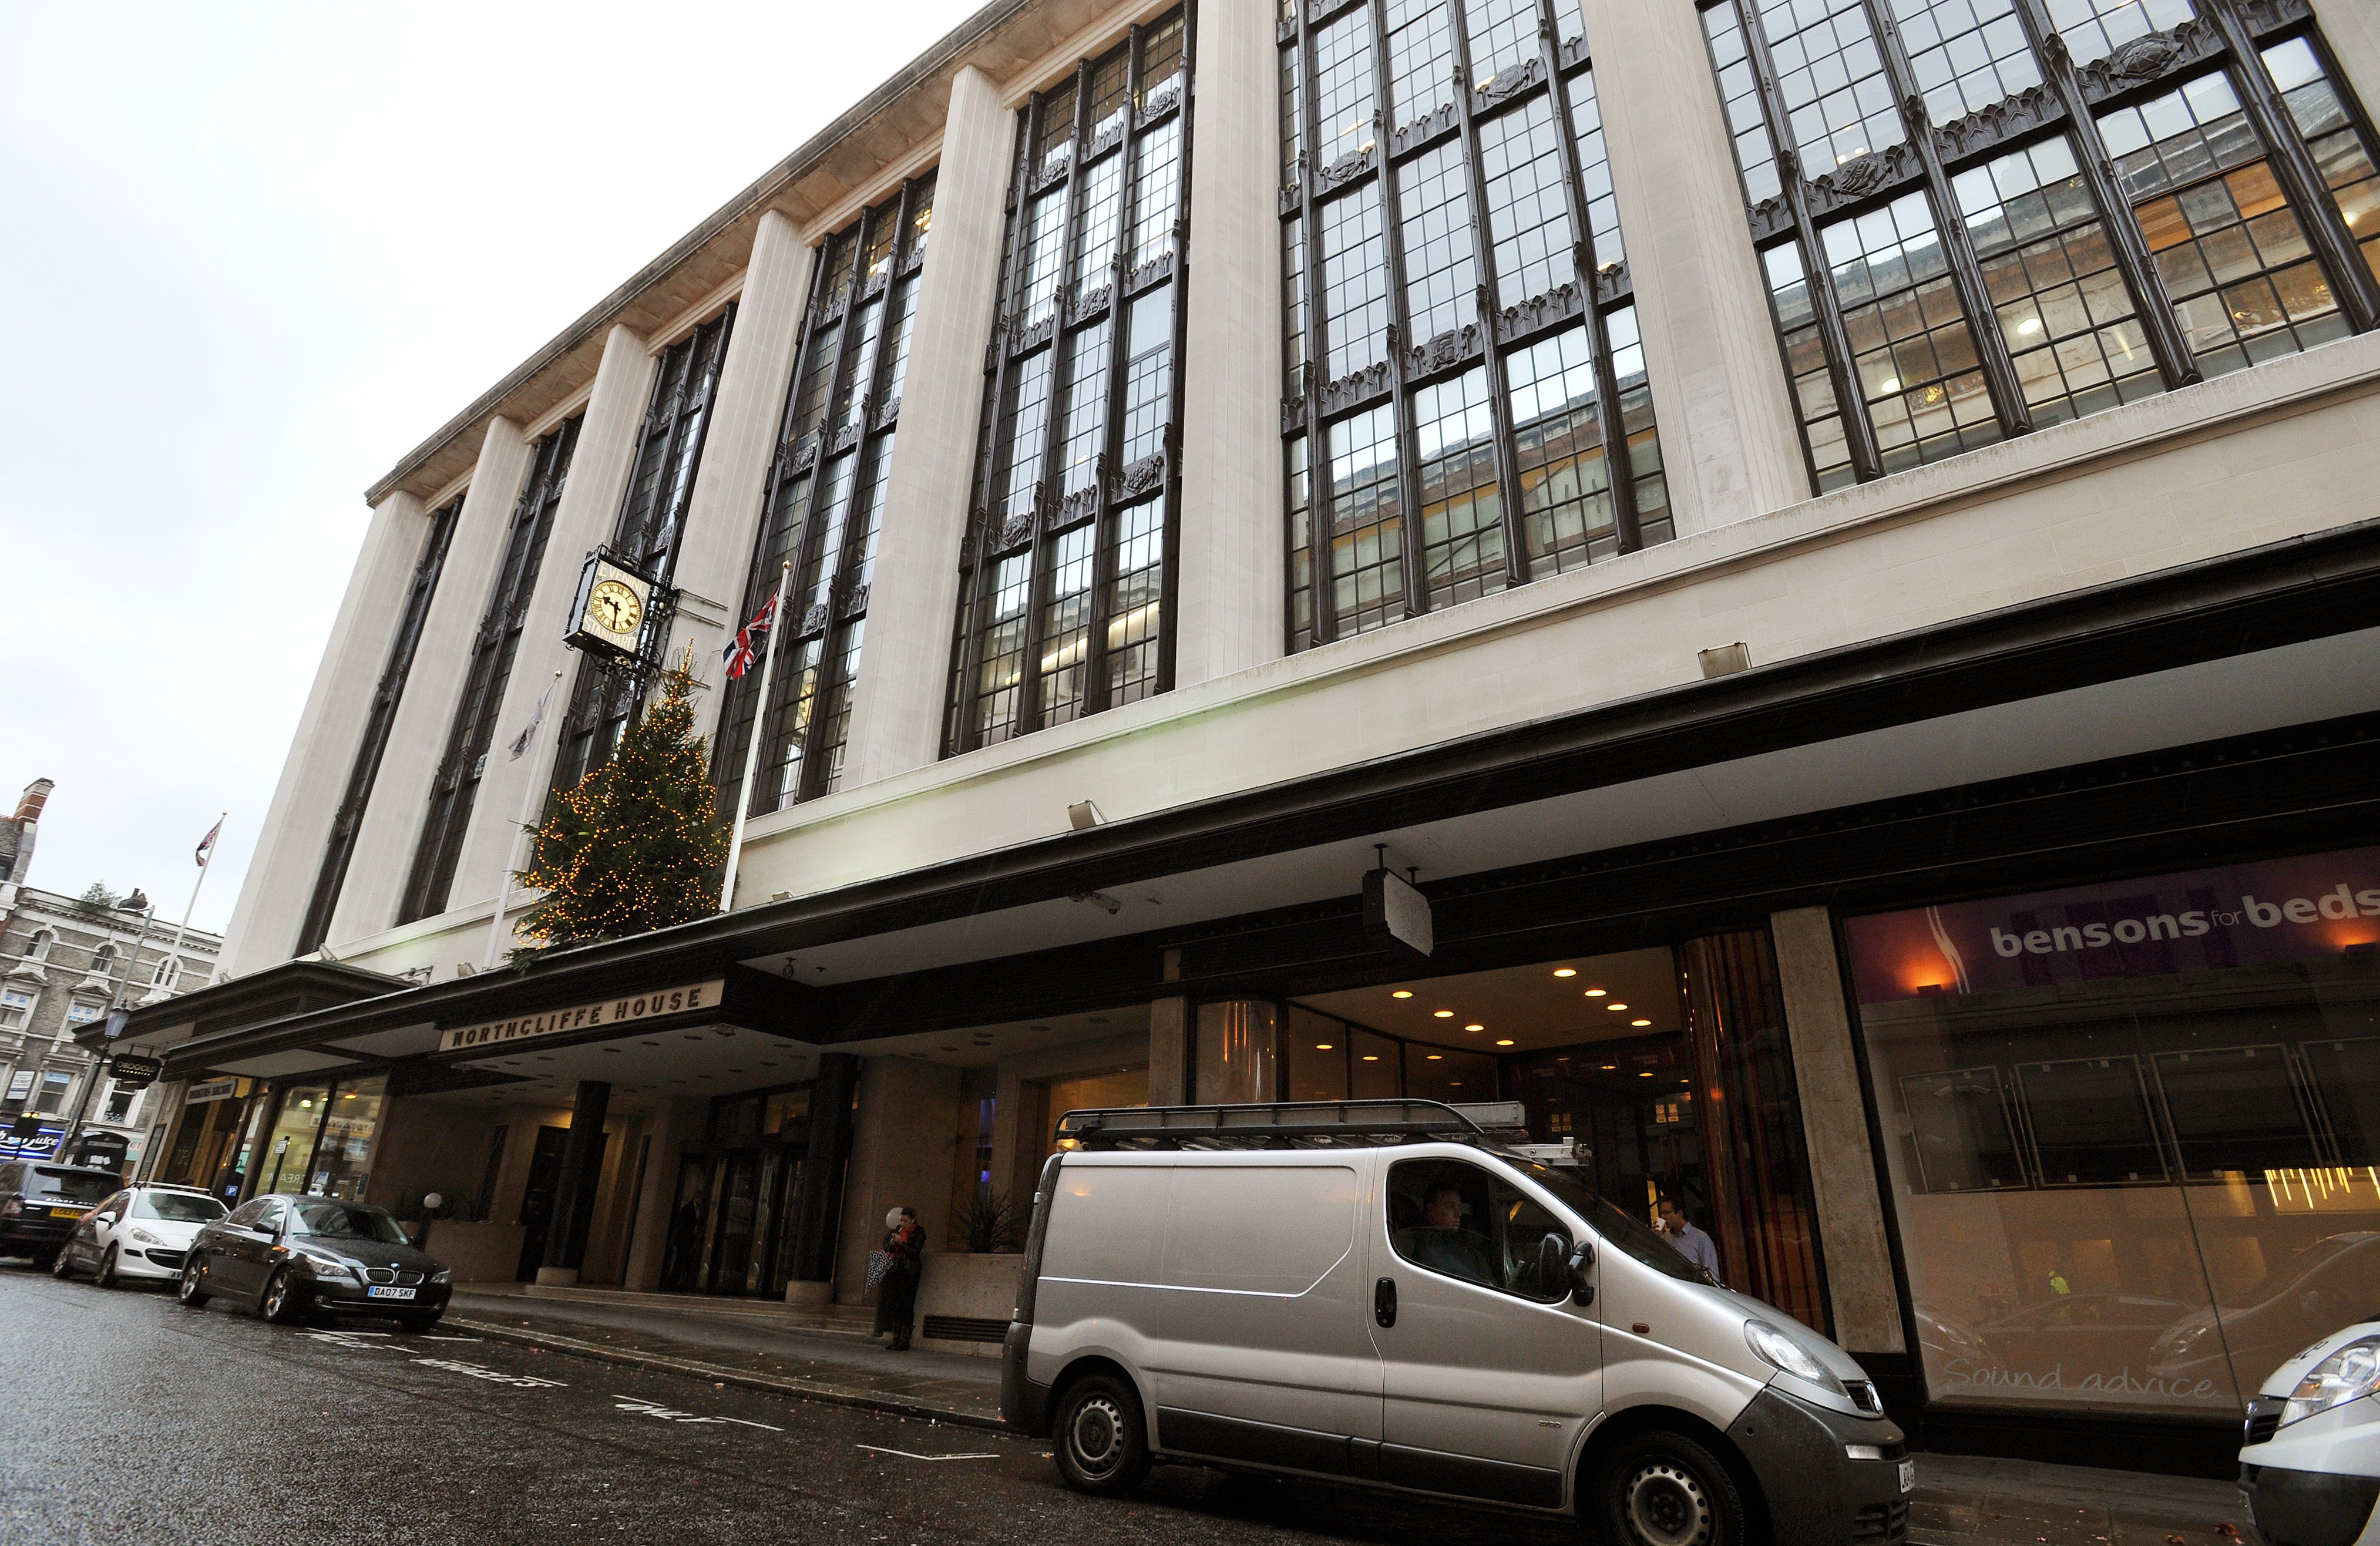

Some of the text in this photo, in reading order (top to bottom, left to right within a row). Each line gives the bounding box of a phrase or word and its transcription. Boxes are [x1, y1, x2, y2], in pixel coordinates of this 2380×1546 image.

[599, 563, 646, 596] EVENING
[583, 616, 636, 651] STANDARD
[1990, 883, 2380, 957] bensons for beds
[452, 988, 701, 1047] NORTHCLIFFE HOUSE
[374, 1288, 397, 1296] DA07
[1943, 1357, 2217, 1399] Sound advice
